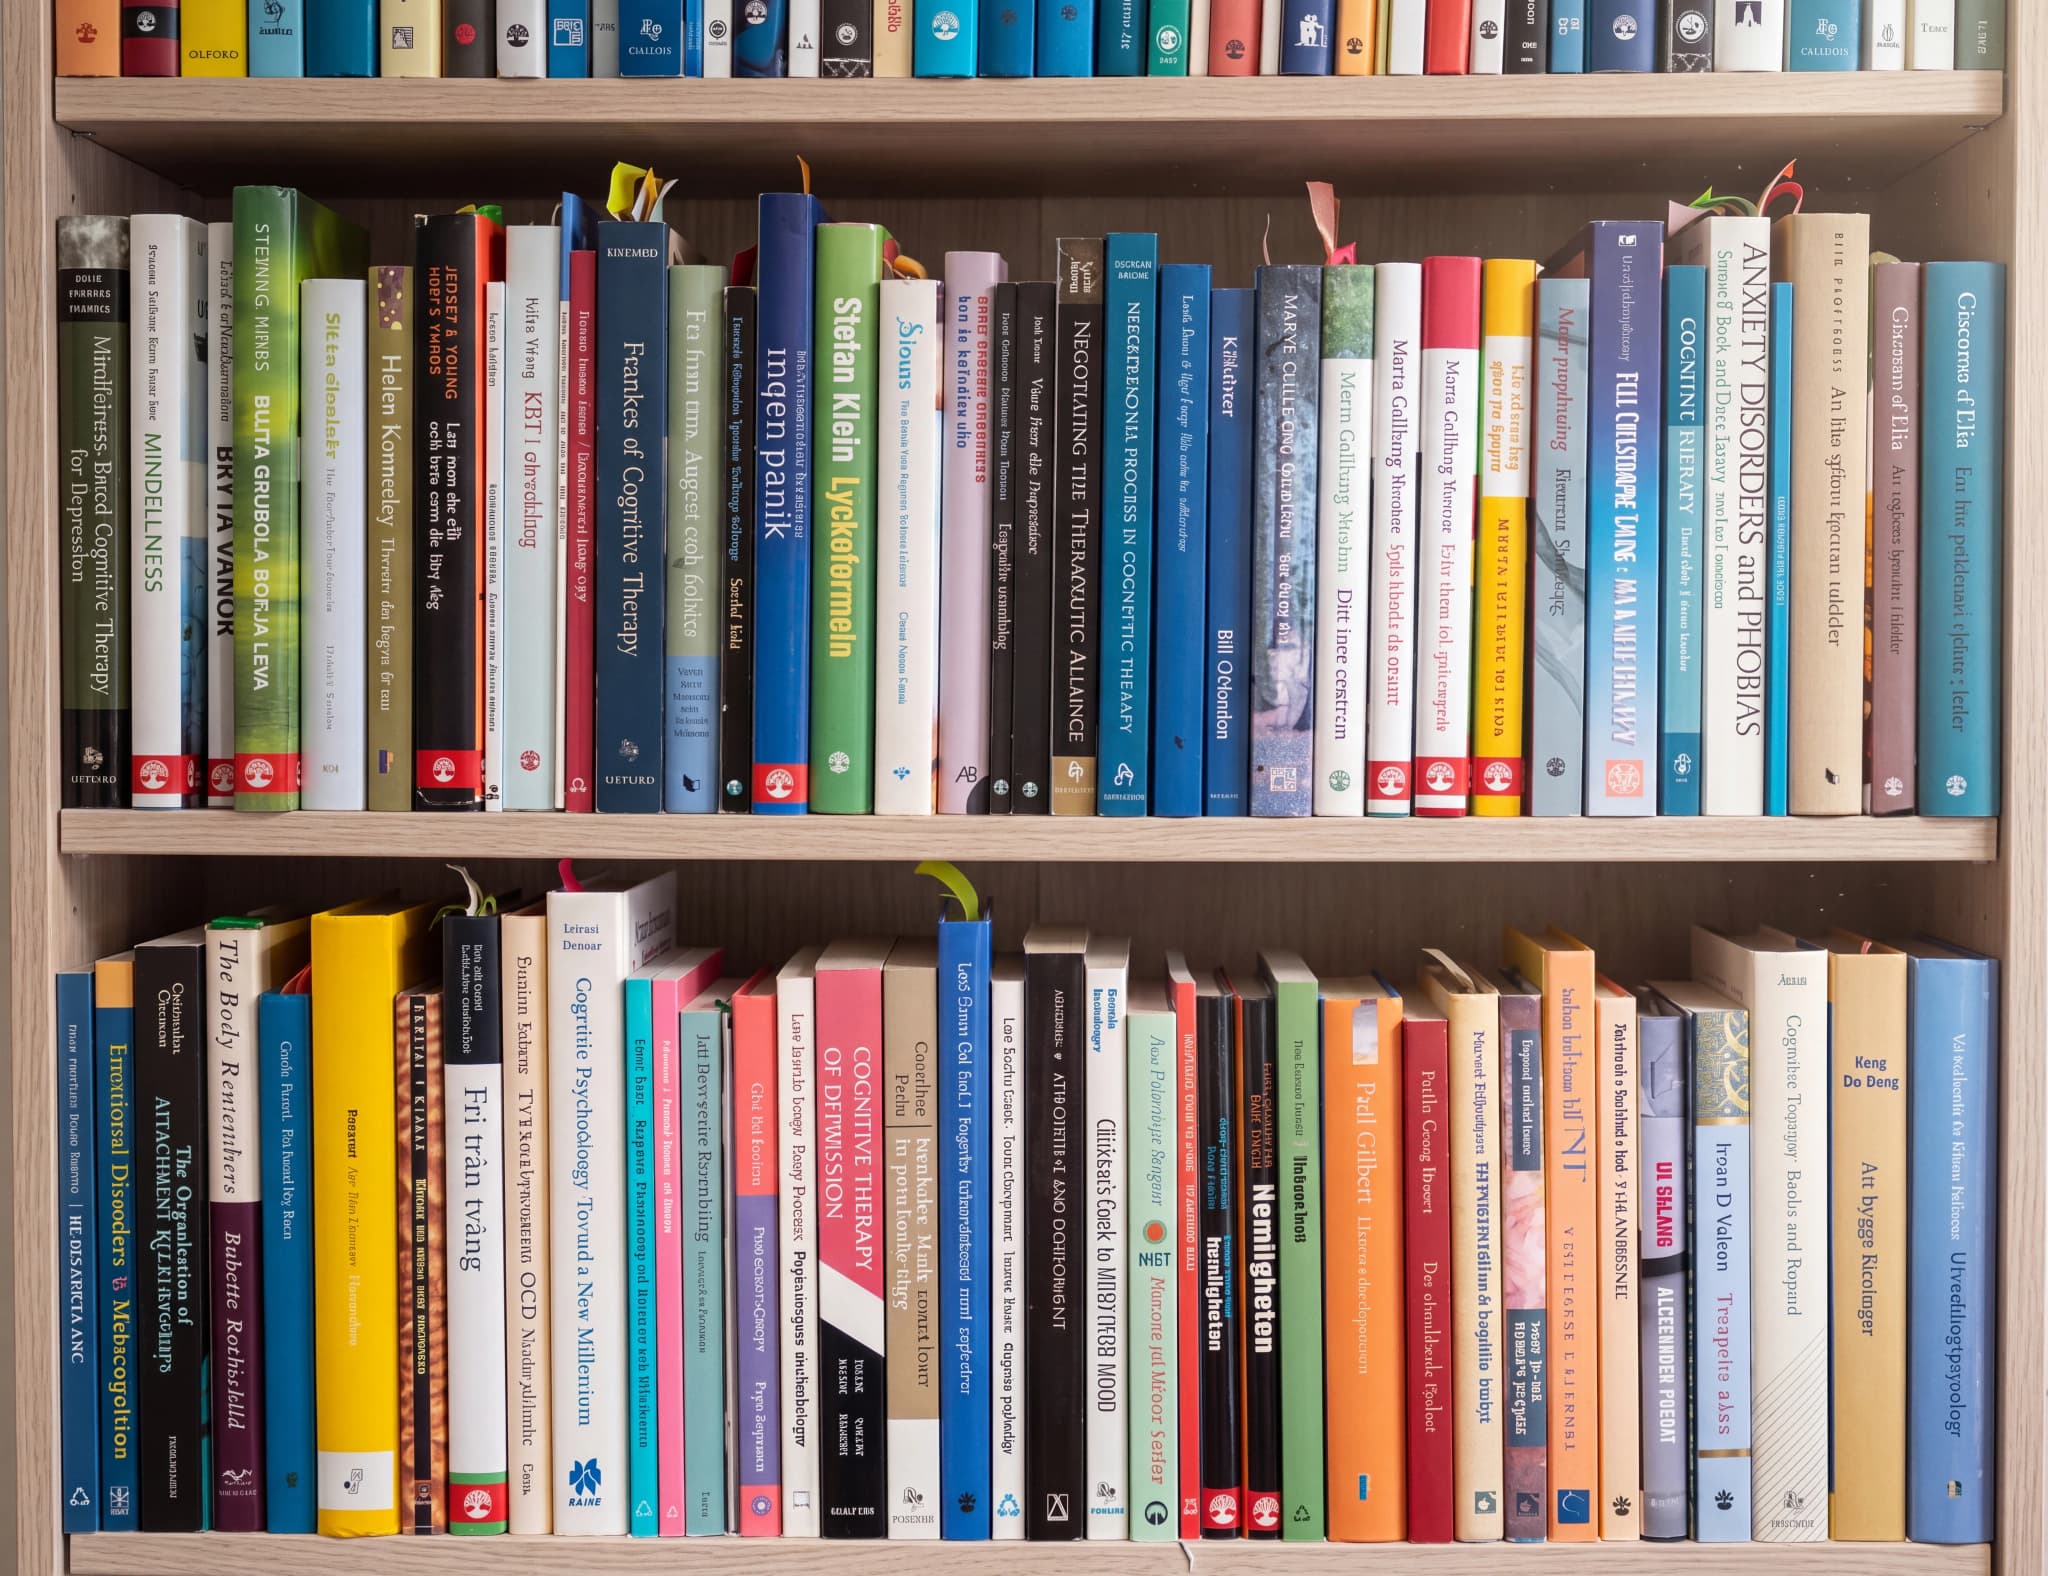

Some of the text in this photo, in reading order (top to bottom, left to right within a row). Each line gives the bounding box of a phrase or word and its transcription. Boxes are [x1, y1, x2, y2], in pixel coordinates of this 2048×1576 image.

[382, 355, 402, 414] Helen
[1392, 340, 1408, 390] Marta
[1715, 359, 1730, 387] and
[524, 391, 542, 434] KBT
[832, 393, 860, 461] Klein
[71, 449, 89, 475] for
[623, 438, 645, 457] of
[761, 450, 791, 539] panik
[1735, 242, 1768, 736] ANXIETY DISORDERS and PHOBIAS
[254, 465, 271, 562] GRUBOLA
[618, 573, 644, 656] Therapy
[1336, 589, 1353, 623] Ditt
[91, 619, 114, 695] Therapy
[1217, 630, 1233, 654] Bill
[254, 643, 268, 690] LEVA
[956, 766, 977, 782] AB
[219, 940, 239, 981] The
[216, 991, 239, 1049] Body
[824, 1047, 841, 1077] OF
[1843, 1075, 1862, 1088] Do
[1855, 1056, 1887, 1071] Keng
[464, 1087, 487, 1124] Fri
[853, 1047, 873, 1271] COGNITIVE THERAPY
[1716, 1194, 1731, 1207] D
[1857, 1162, 1878, 1248] Att bygge
[1787, 1223, 1802, 1251] and
[577, 1267, 589, 1275] a
[520, 1272, 536, 1320] OCD
[577, 1282, 594, 1321] New
[178, 1308, 192, 1326] of
[1097, 1365, 1116, 1412] MOOD
